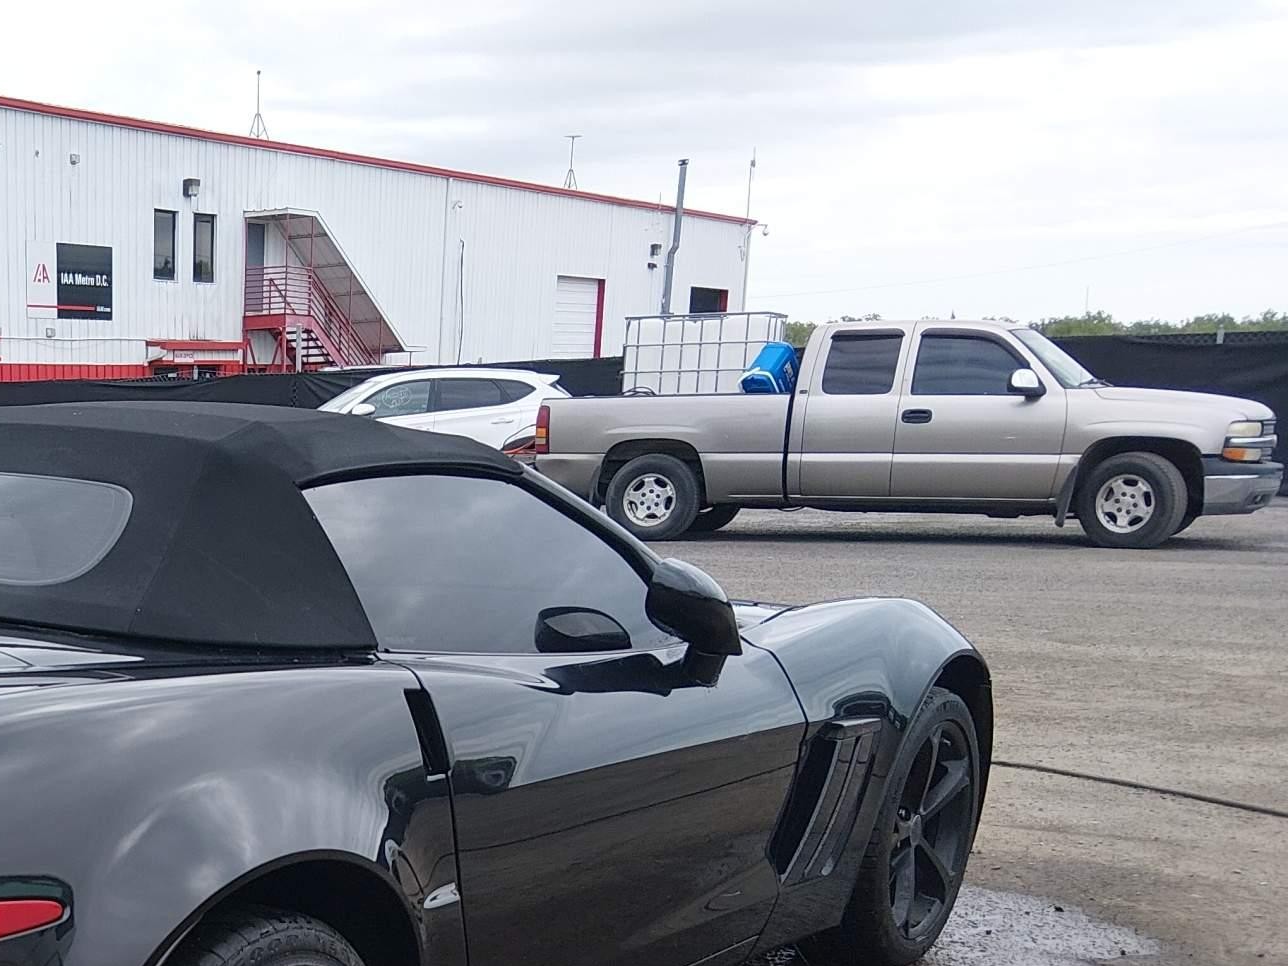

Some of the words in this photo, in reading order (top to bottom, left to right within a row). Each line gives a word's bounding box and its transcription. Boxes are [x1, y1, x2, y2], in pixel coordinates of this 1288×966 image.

[60, 272, 74, 285] IAA
[74, 273, 95, 286] Metro
[95, 274, 109, 287] D.C.
